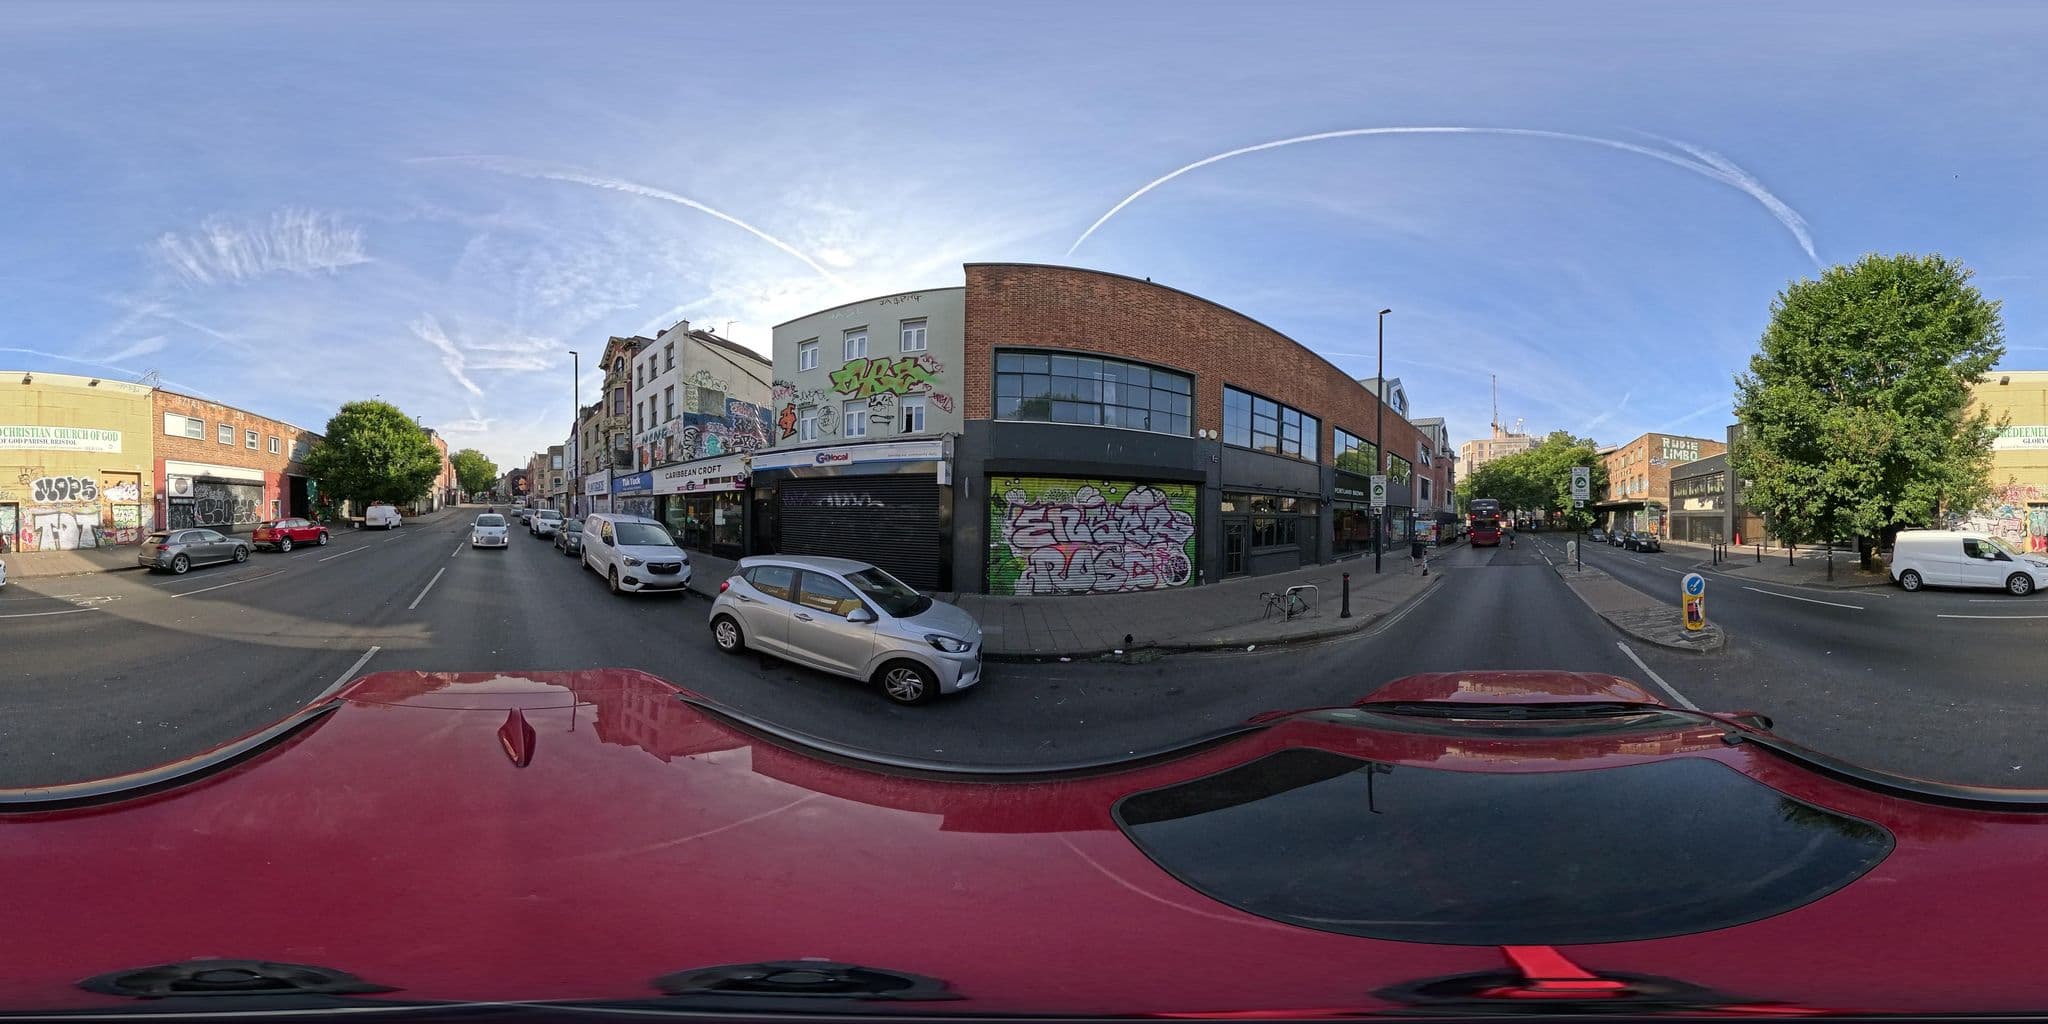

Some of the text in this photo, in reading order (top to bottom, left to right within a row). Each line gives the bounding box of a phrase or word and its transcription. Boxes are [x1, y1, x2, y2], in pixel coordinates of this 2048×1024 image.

[3, 426, 119, 442] CHRISTIAN CHURCH OF GOD
[665, 464, 722, 480] CARIBBEAN CROFT
